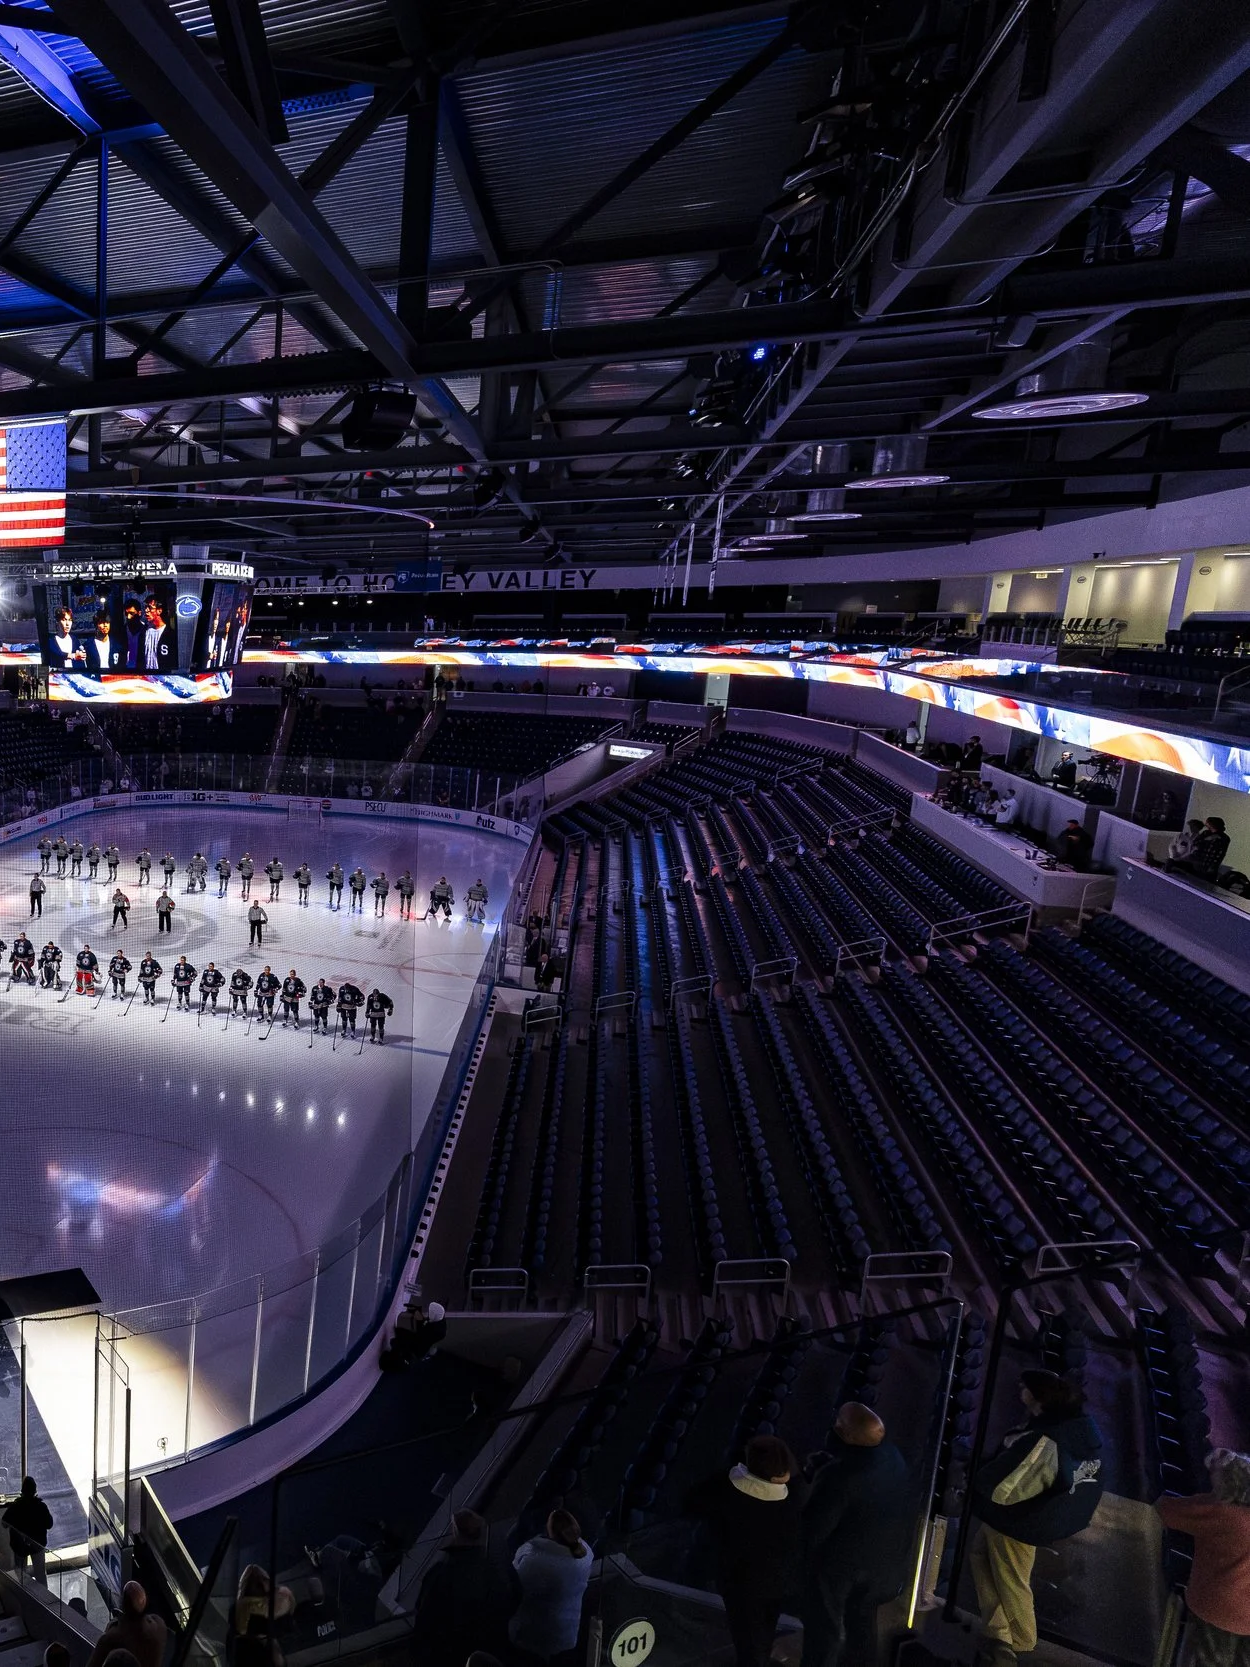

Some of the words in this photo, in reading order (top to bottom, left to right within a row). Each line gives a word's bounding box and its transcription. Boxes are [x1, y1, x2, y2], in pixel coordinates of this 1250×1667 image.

[212, 562, 240, 577] PEGULA
[487, 569, 598, 591] VALLEY
[161, 645, 169, 655] S
[152, 793, 174, 801] LIGHT
[365, 801, 387, 813] PSECU
[618, 1632, 647, 1657] 101
